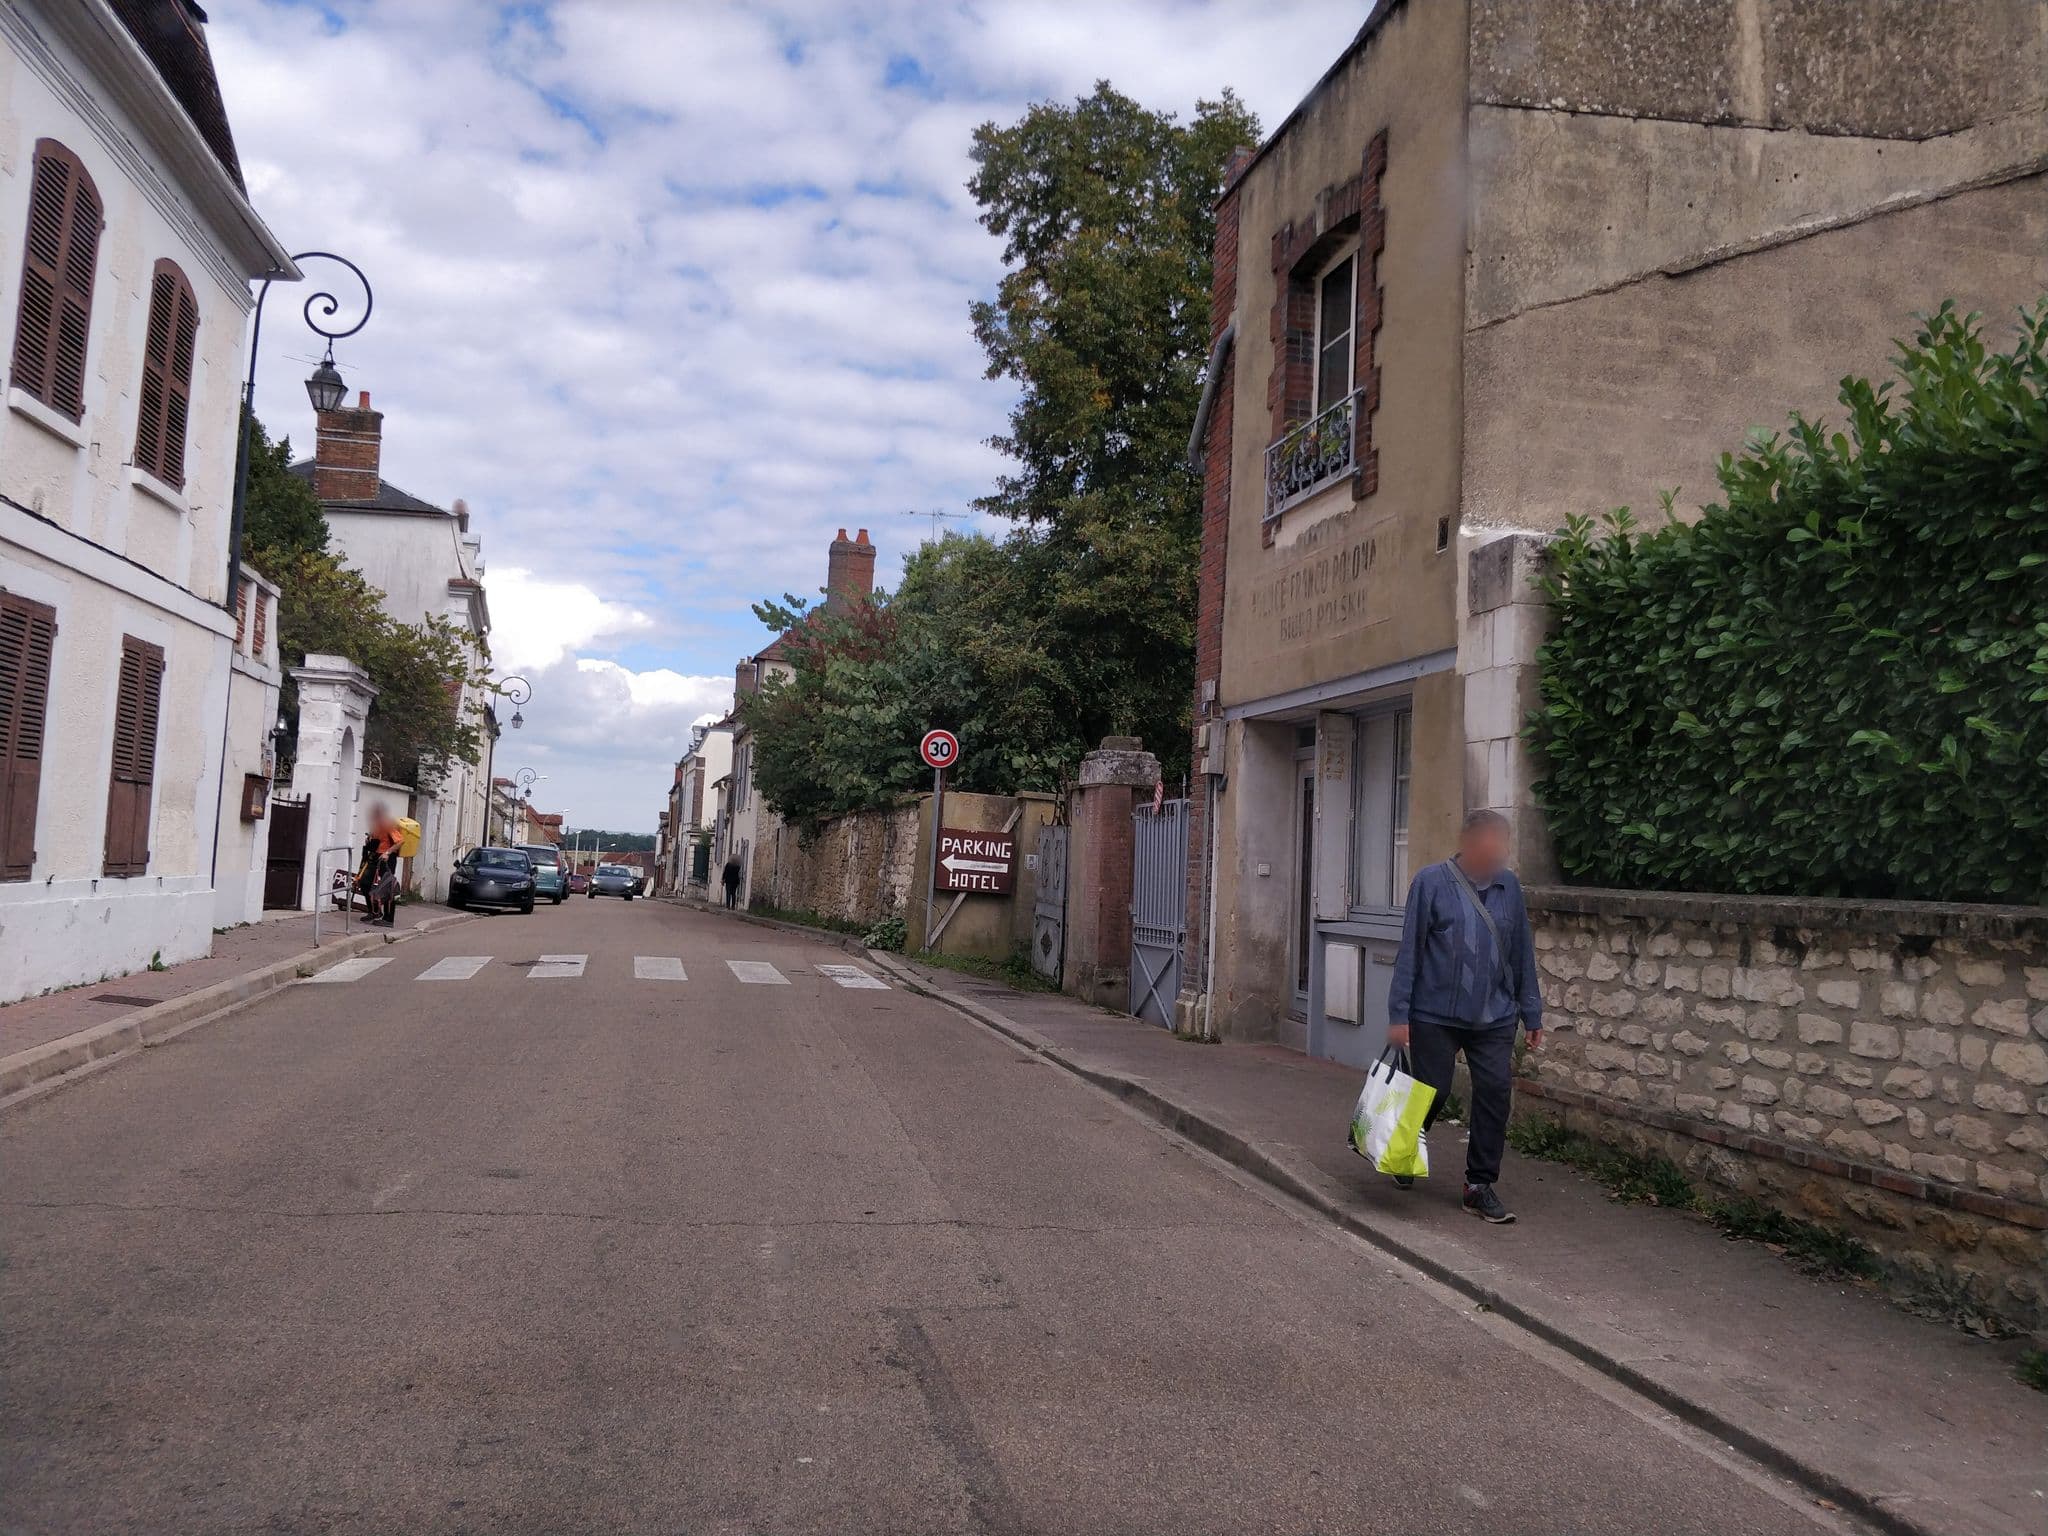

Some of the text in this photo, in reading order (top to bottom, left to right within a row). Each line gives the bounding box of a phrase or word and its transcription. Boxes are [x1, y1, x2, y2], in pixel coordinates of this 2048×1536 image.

[930, 741, 951, 757] 30
[941, 838, 1013, 859] PARKING
[949, 873, 1000, 890] HOTEL
